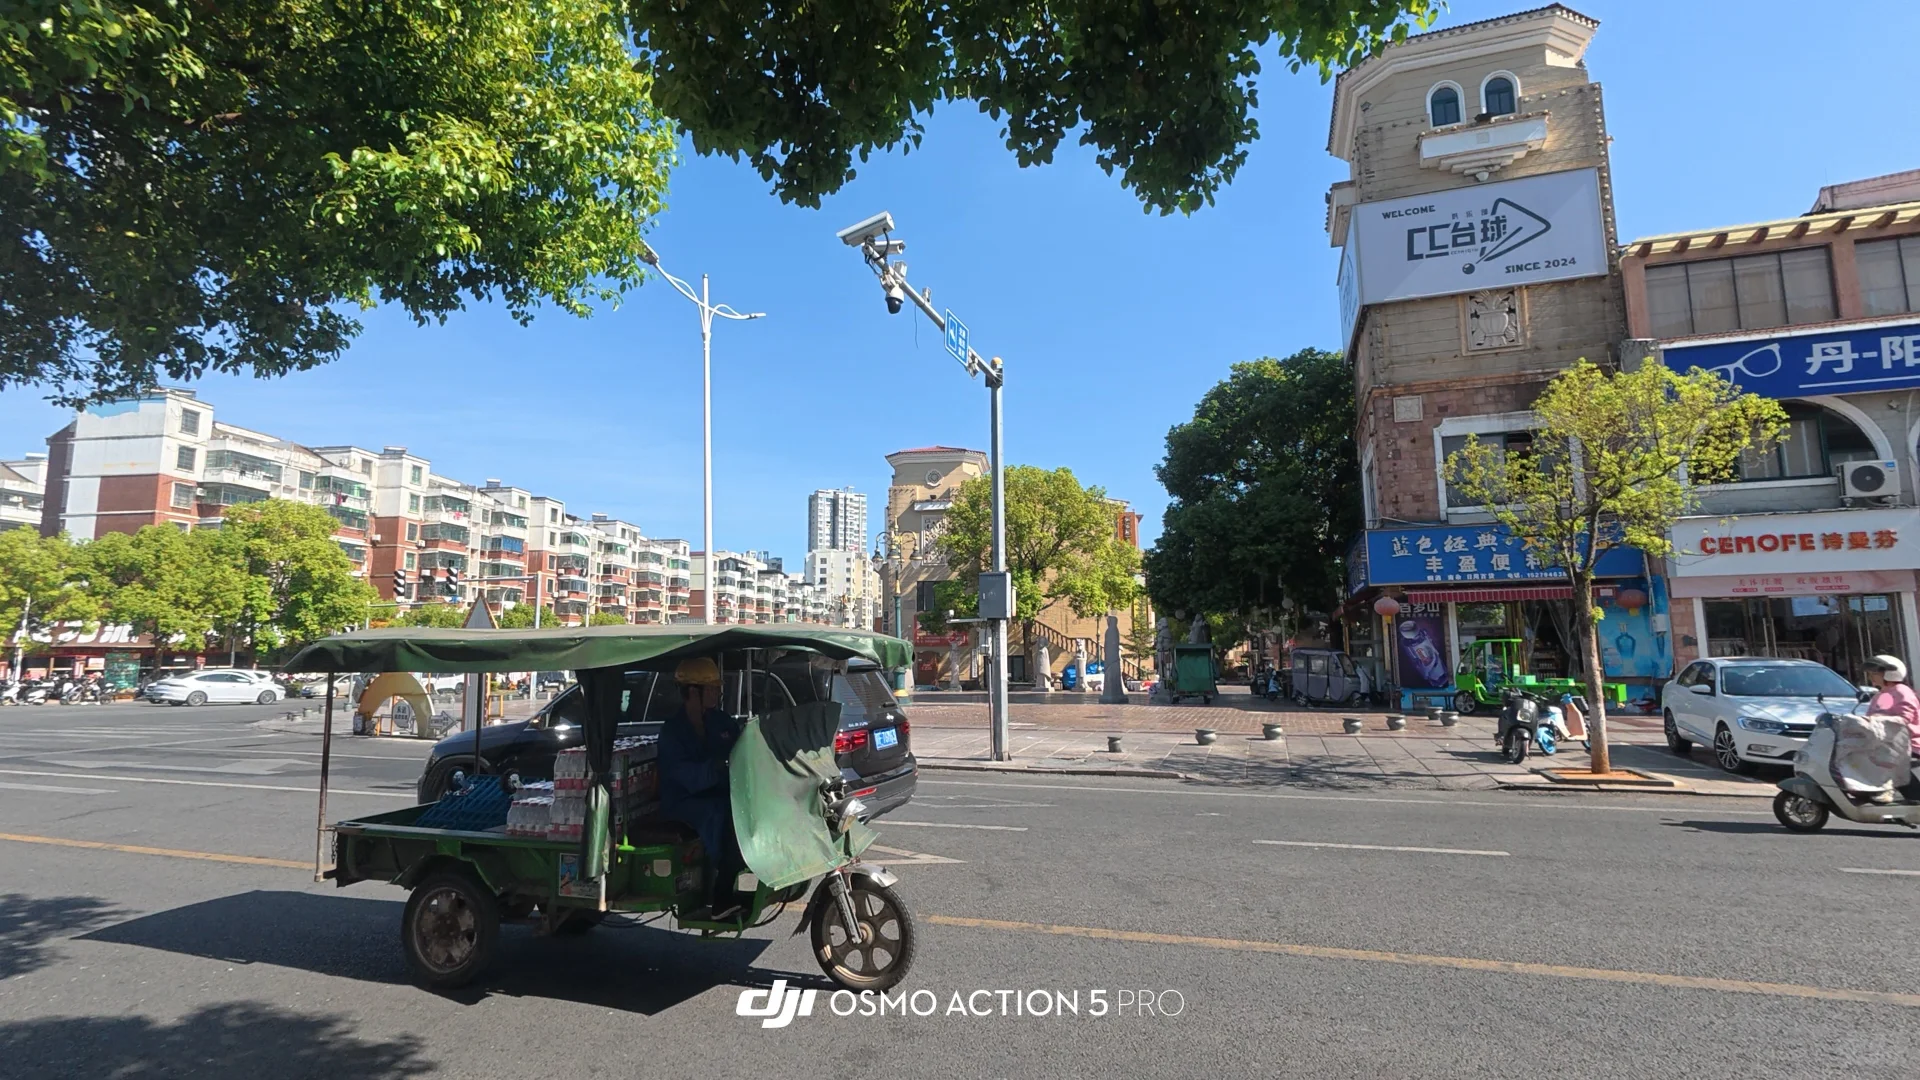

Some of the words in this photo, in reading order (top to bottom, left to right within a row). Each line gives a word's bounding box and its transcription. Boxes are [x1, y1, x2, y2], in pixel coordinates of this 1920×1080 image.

[1381, 204, 1436, 220] WELCOME
[1504, 261, 1541, 274] SINCE
[1543, 257, 1577, 269] 2024
[1700, 533, 1816, 554] CEMOFE
